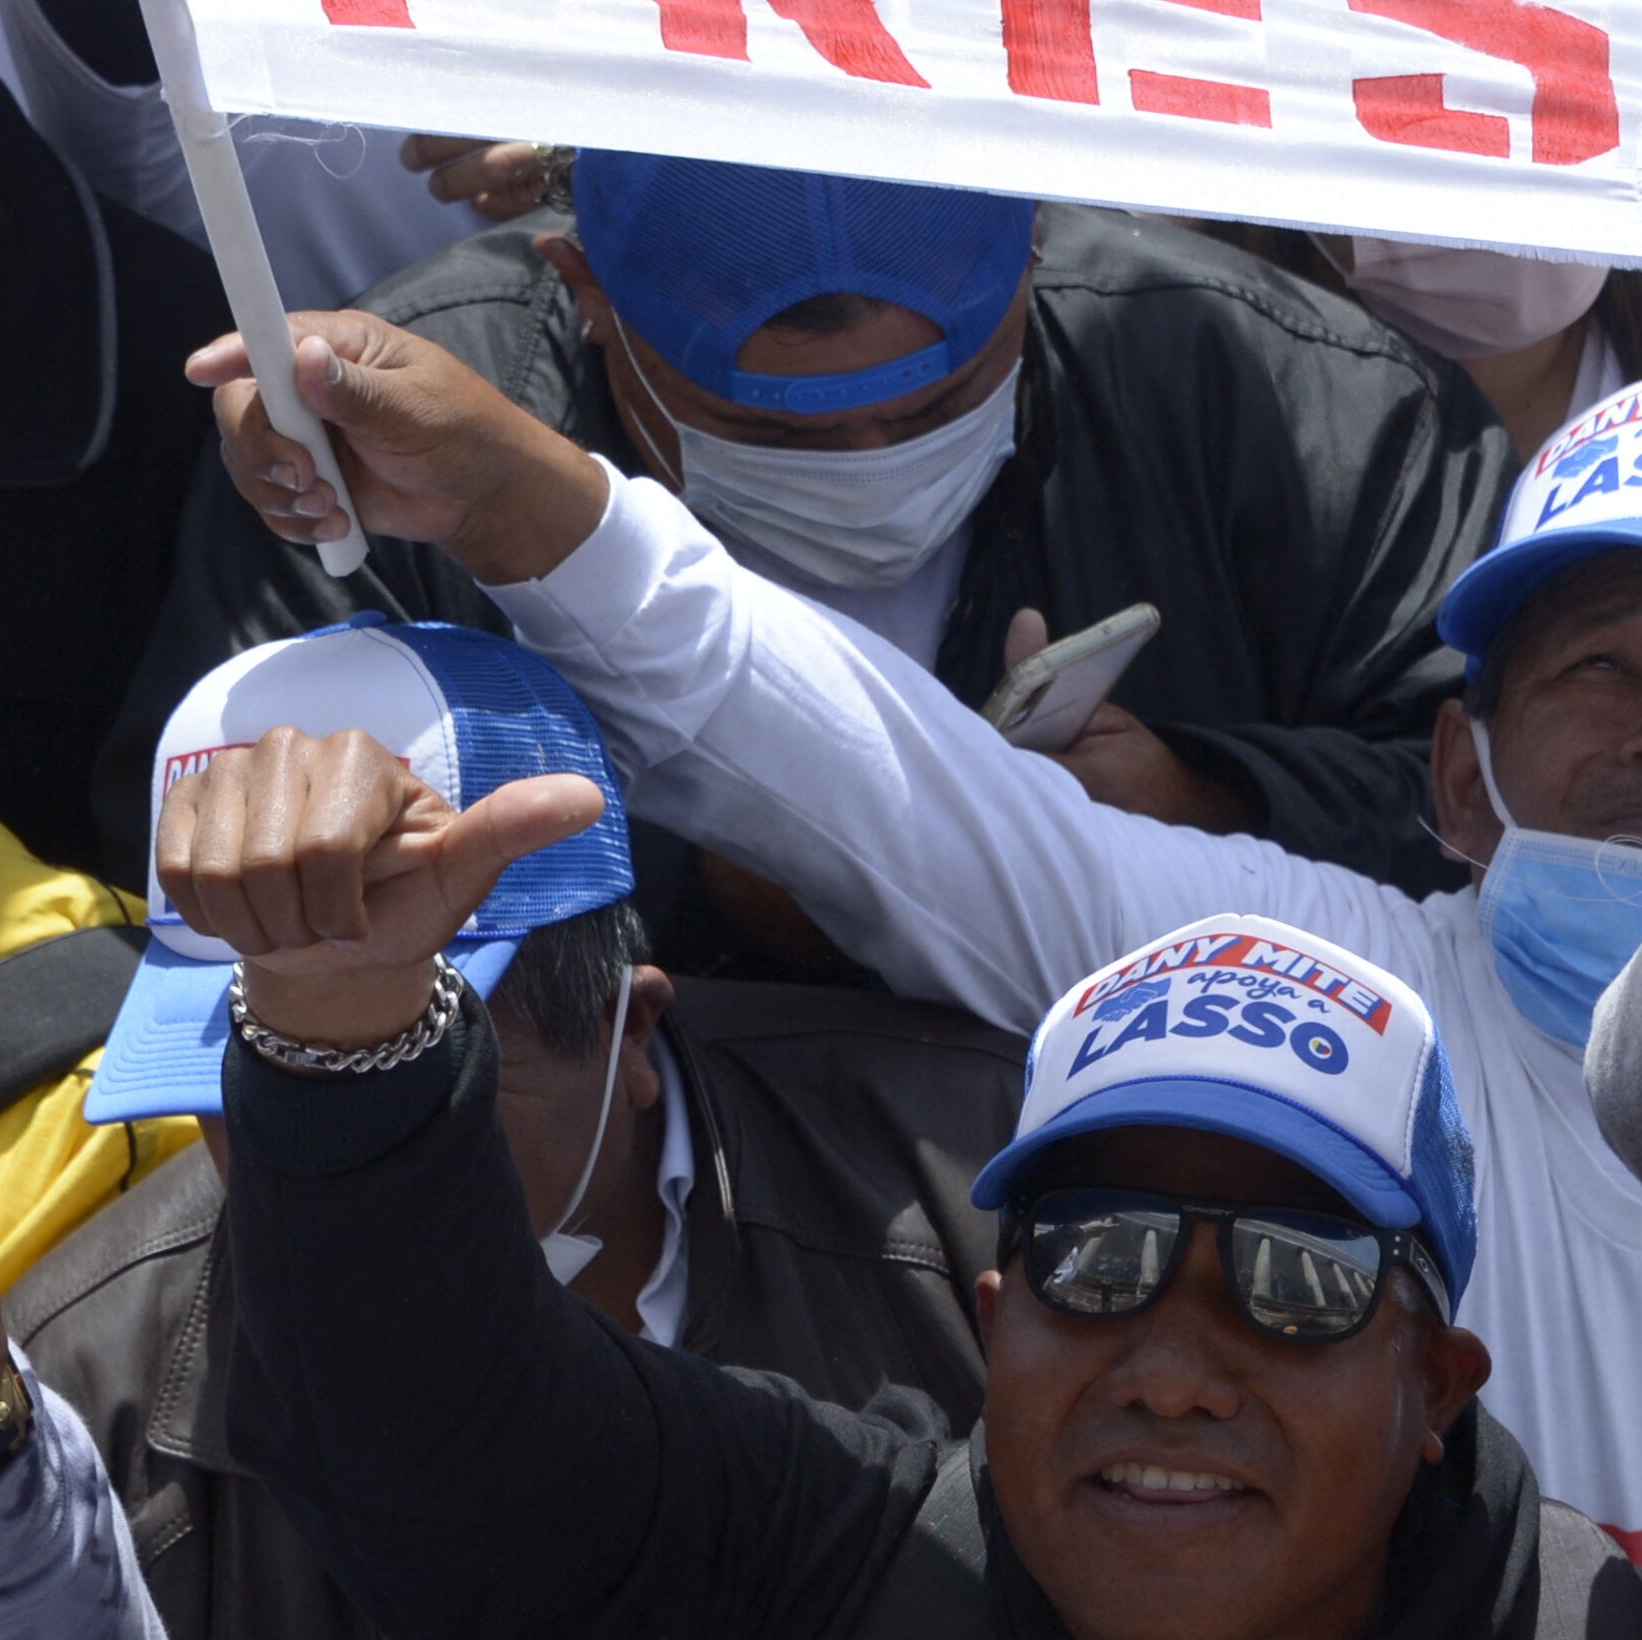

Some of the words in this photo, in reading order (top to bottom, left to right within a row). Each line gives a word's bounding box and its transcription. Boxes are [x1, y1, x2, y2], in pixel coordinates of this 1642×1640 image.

[1085, 935, 1241, 1006] DANY
[1240, 940, 1385, 1022] MITE
[1186, 969, 1302, 1000] apoya
[1307, 998, 1331, 1014] a
[1065, 993, 1350, 1082] LASSO
